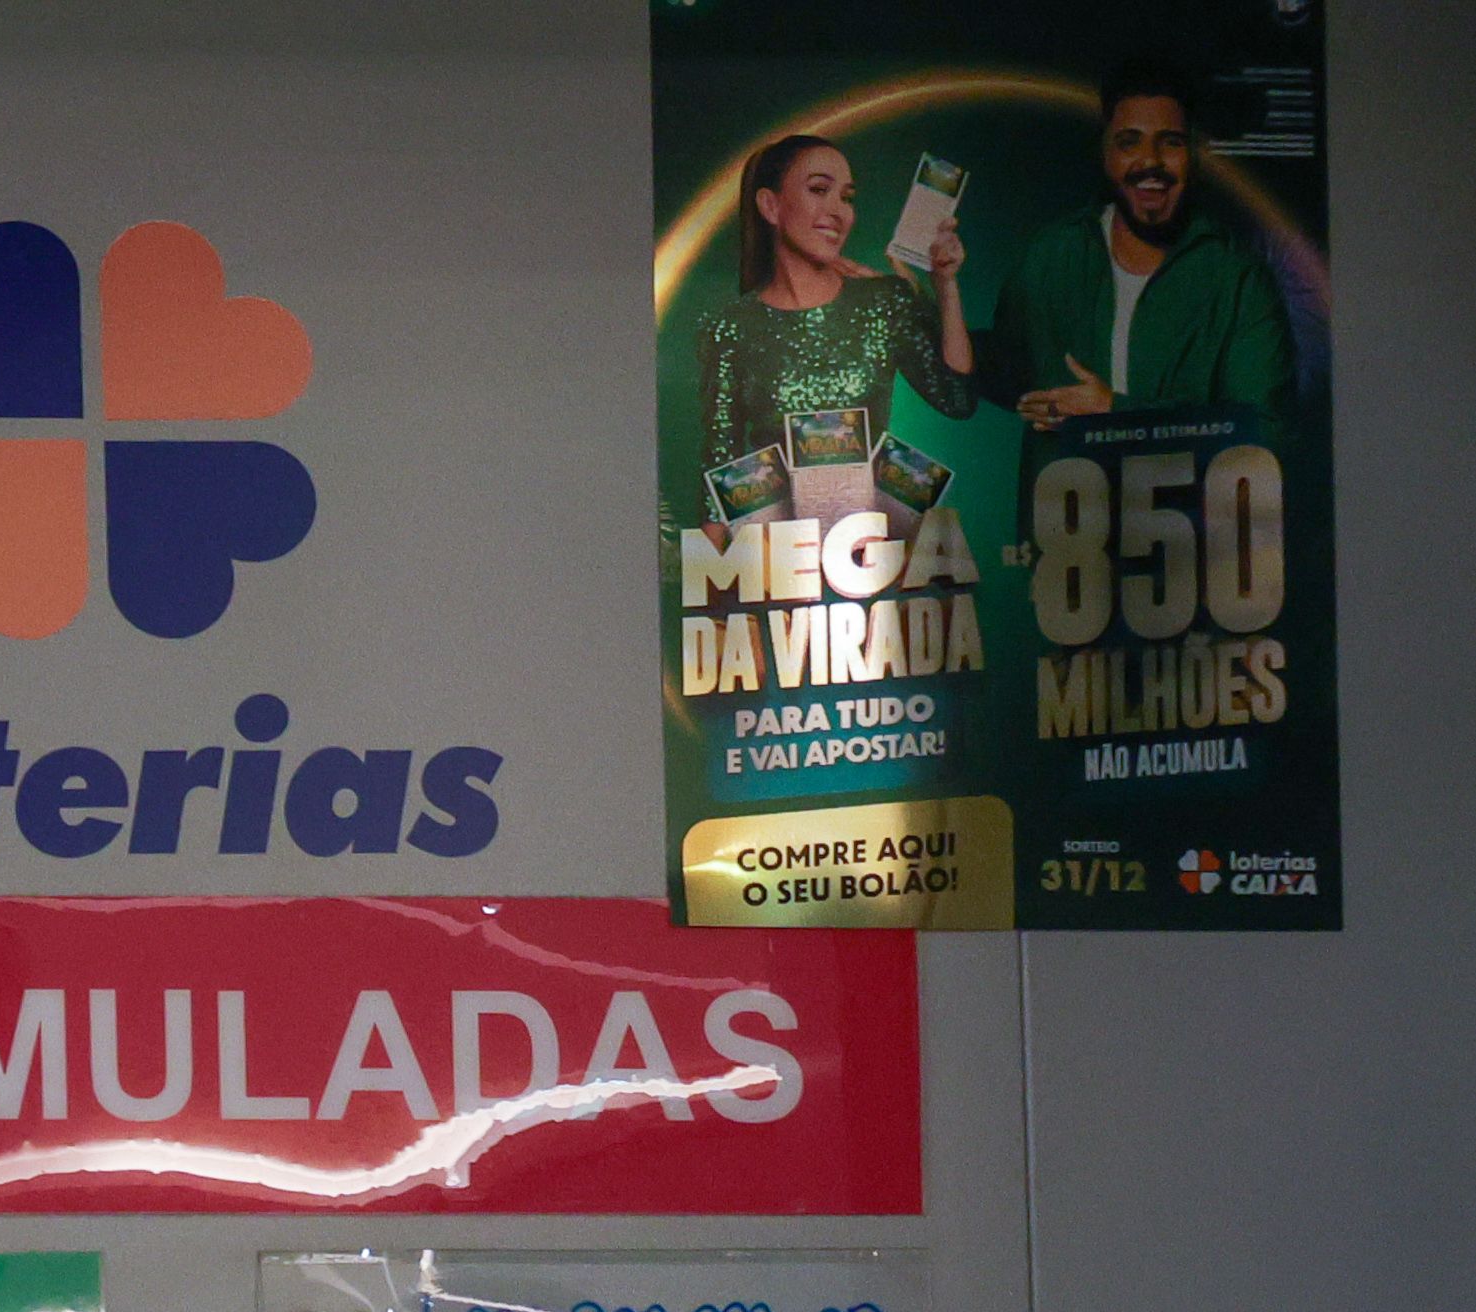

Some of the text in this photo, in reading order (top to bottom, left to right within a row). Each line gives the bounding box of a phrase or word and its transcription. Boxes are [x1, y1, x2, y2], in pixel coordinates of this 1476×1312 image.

[681, 505, 980, 608] MEGA
[1031, 445, 1285, 646] 850
[682, 593, 984, 696] DA VIRADA
[1037, 632, 1286, 739] MILHÕES
[736, 694, 935, 739] PARA TUDO
[726, 729, 945, 774] E VAI APOSTAR!
[1084, 737, 1247, 781] NÃO ACUMULA
[737, 831, 957, 873] COMPRE AQUI
[1063, 840, 1120, 854] SORTEIO
[1230, 848, 1317, 872] loterias
[743, 866, 959, 906] O SEU BOLÃO!
[1040, 858, 1146, 895] 31/12
[1230, 874, 1318, 895] CAIXA
